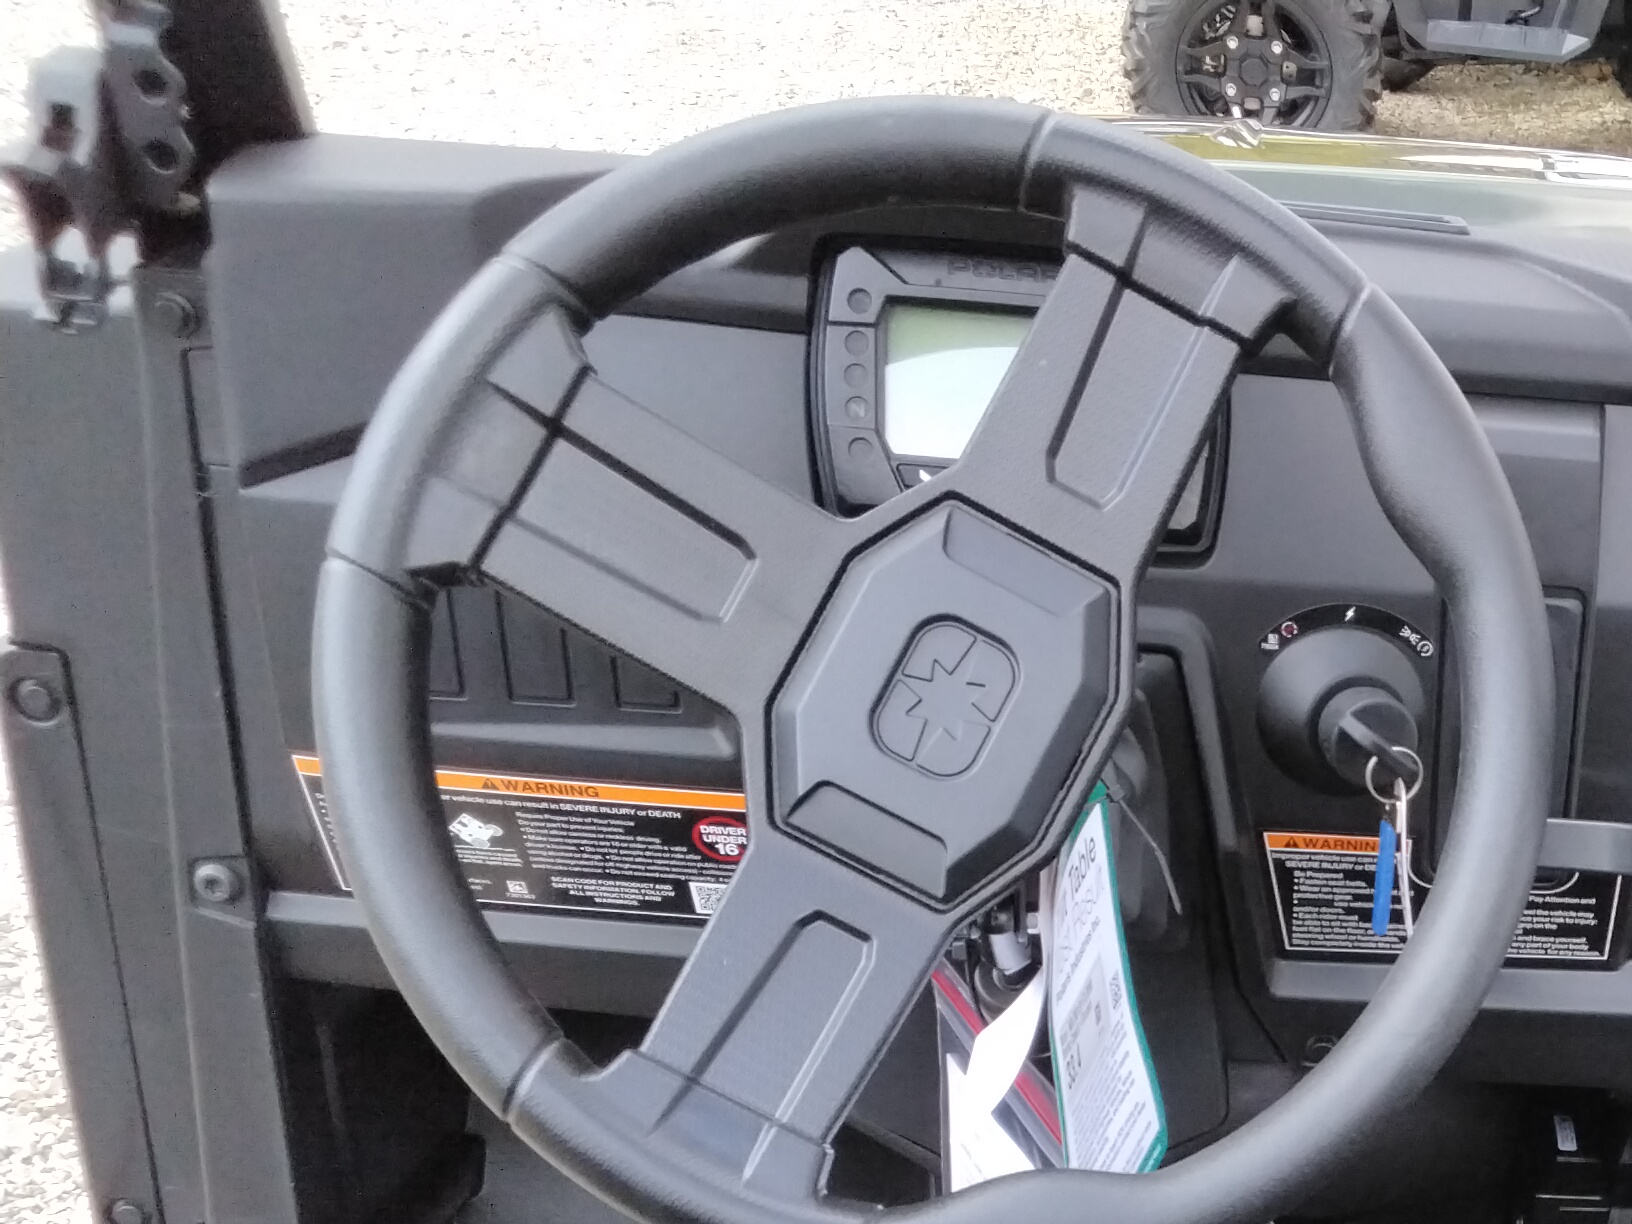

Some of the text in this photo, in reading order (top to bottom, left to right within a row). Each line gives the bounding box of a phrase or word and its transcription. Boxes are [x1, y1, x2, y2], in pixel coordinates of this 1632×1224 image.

[501, 779, 599, 797] WARNING
[452, 795, 485, 804] vehicle
[560, 803, 598, 813] SEVERE
[600, 807, 635, 815] INJURY
[648, 810, 682, 819] DEATH
[699, 825, 747, 836] DRIVER
[702, 834, 748, 845] UNDER
[1303, 838, 1377, 852] WARNIN
[714, 844, 739, 856] 16
[1311, 853, 1340, 861] vehicle
[1069, 836, 1097, 900] Table
[1285, 860, 1320, 868] SEVERE
[1321, 862, 1354, 870] INJURY
[1306, 871, 1344, 879] Prepared
[616, 880, 654, 889] PRODUCT
[640, 888, 675, 896] FOLLOW
[1529, 895, 1544, 904] Pay
[1544, 895, 1580, 903] Attention
